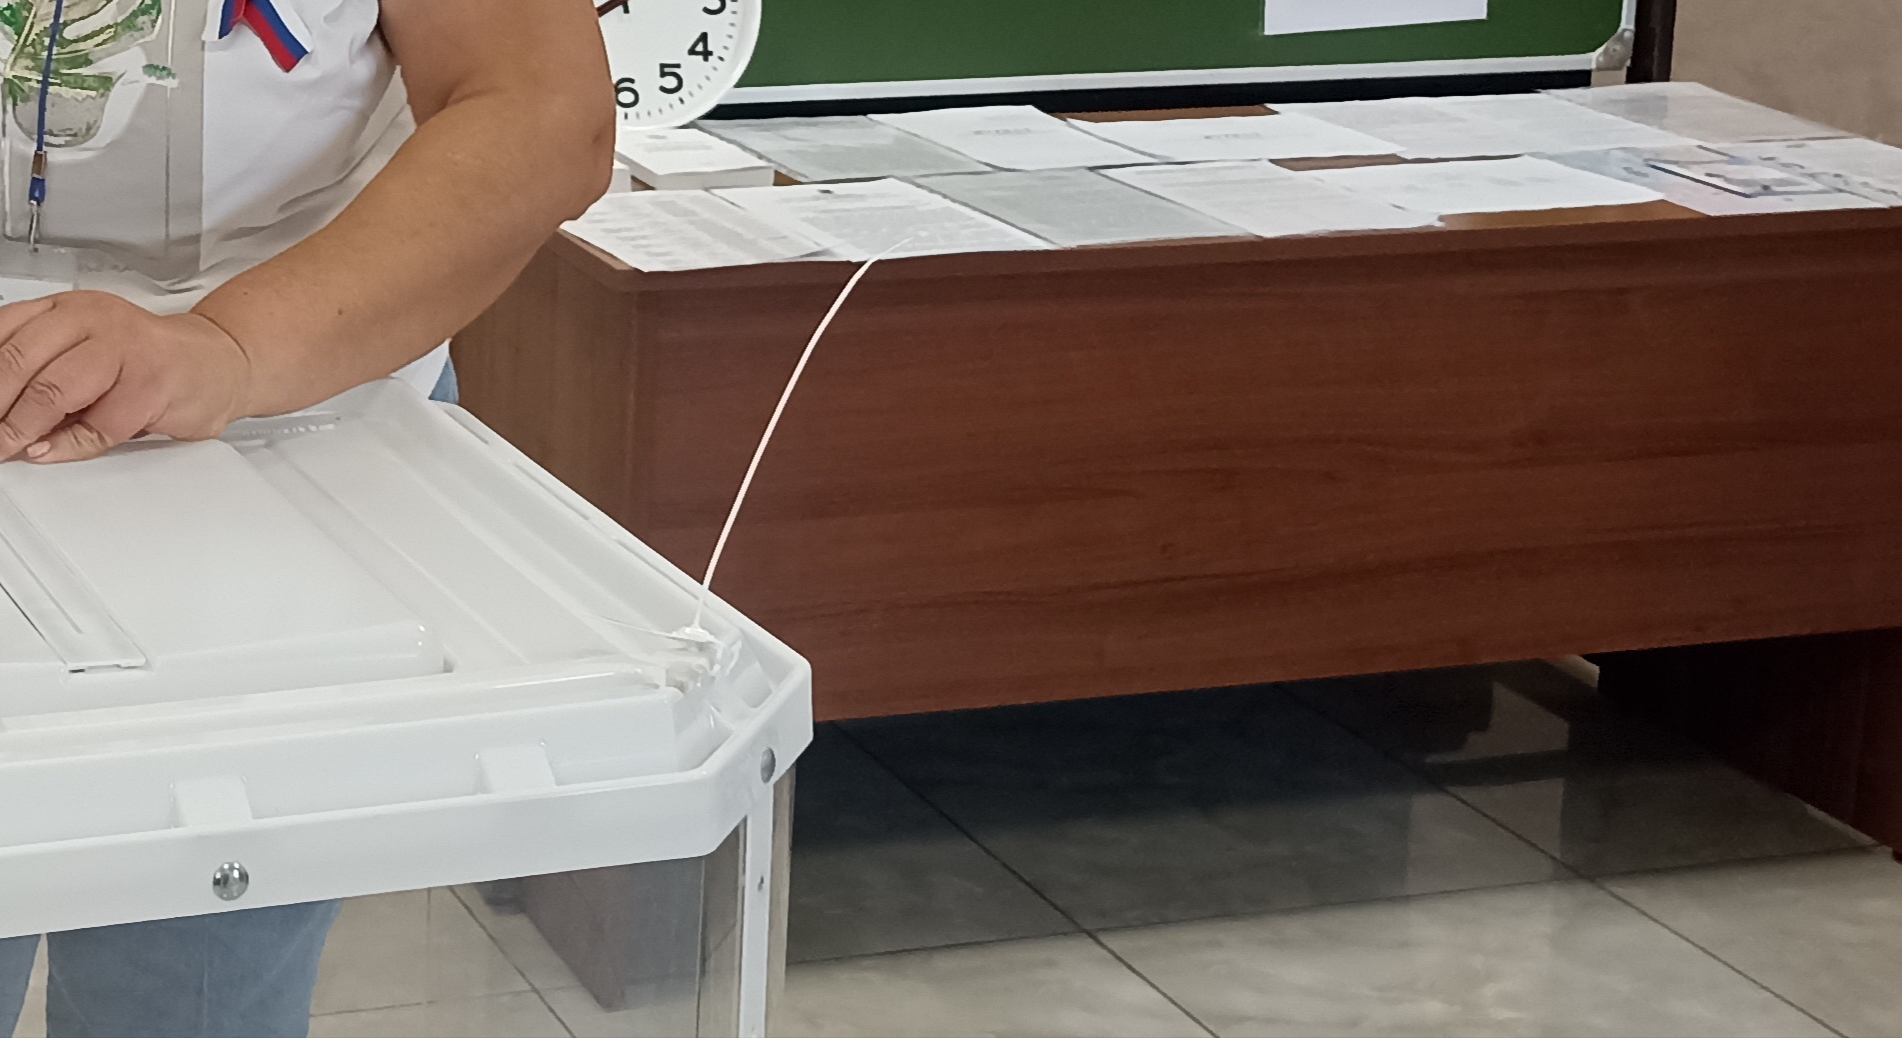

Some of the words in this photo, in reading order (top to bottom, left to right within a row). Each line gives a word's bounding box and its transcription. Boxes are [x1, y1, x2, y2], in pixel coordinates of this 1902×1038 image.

[687, 31, 714, 62] 4
[614, 77, 640, 108] 6
[658, 62, 684, 94] 5
